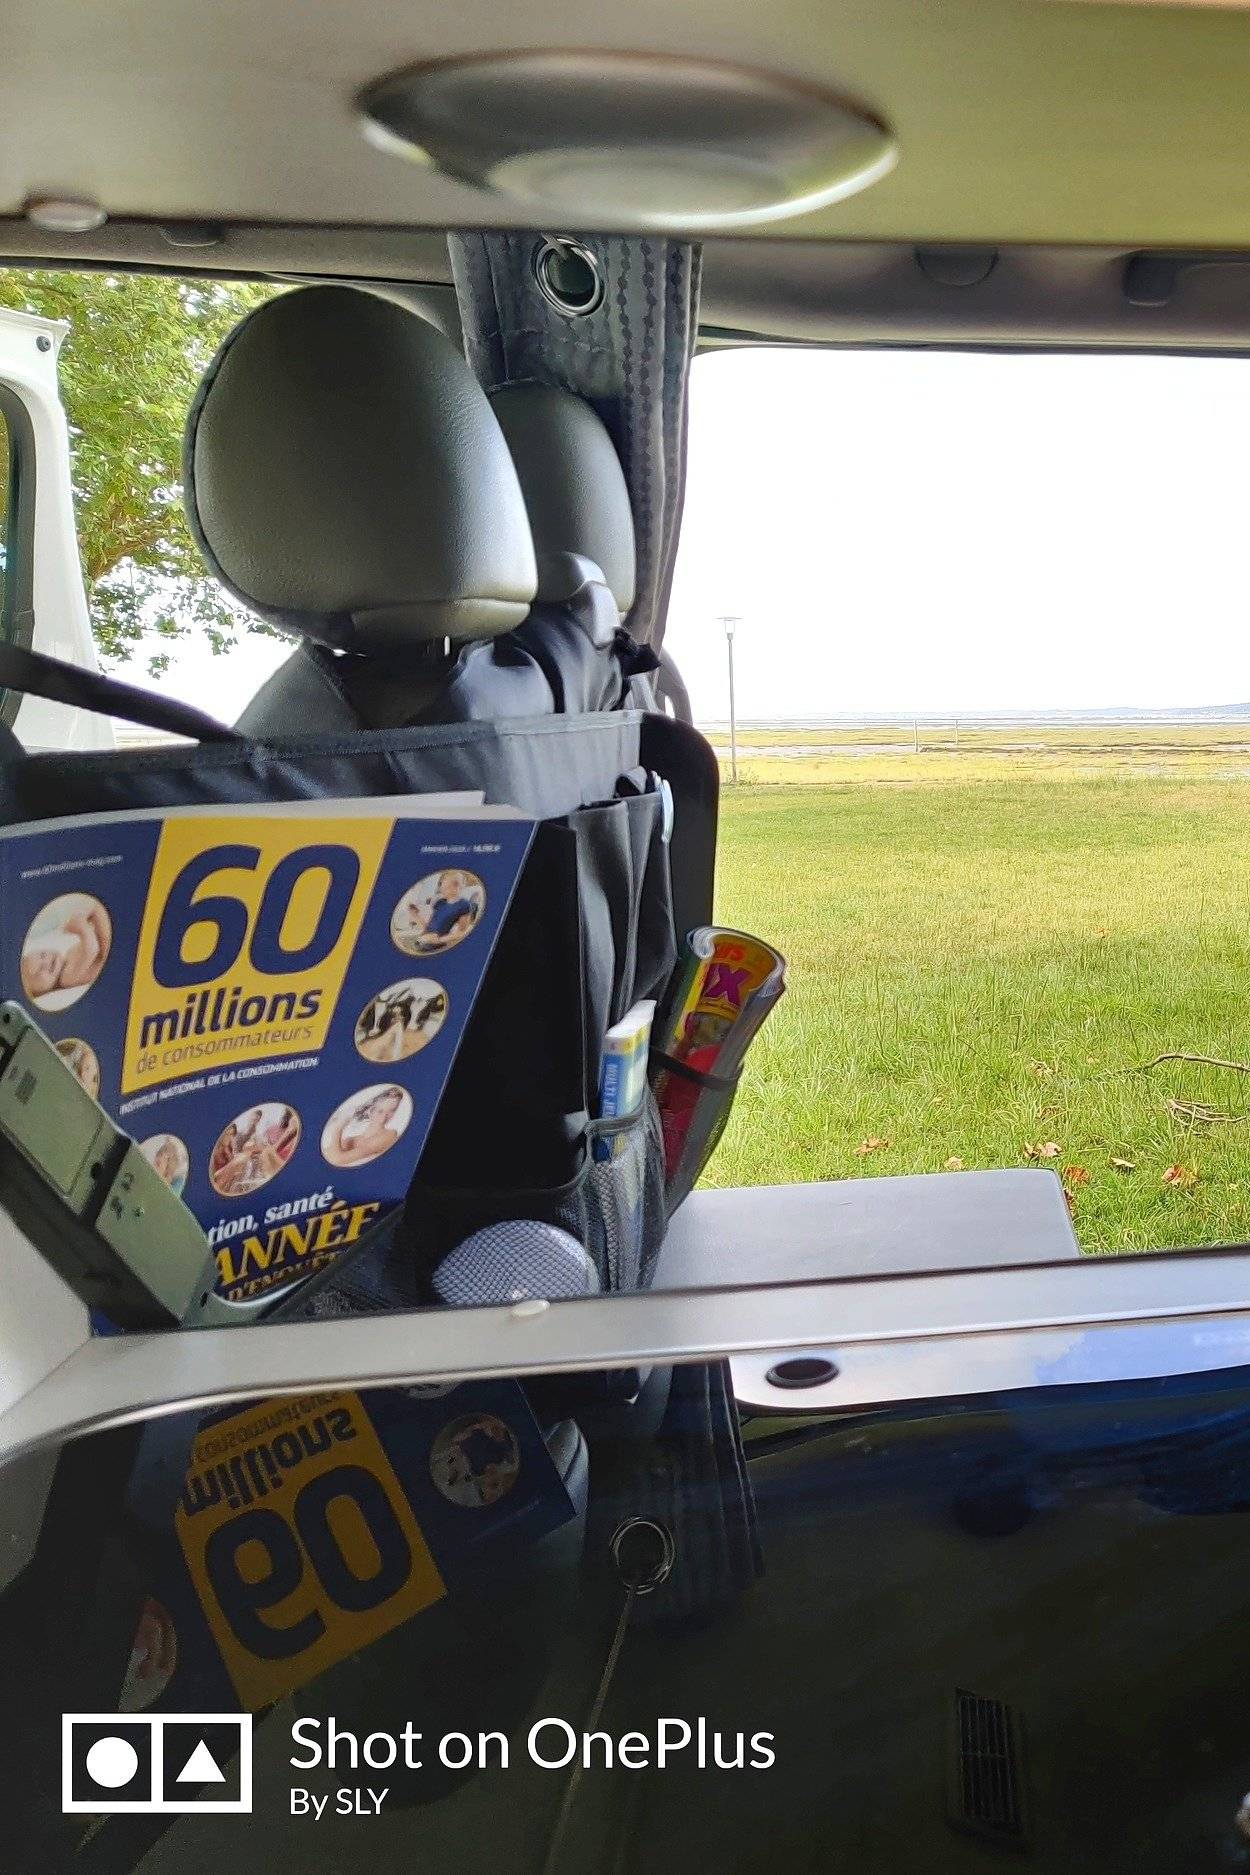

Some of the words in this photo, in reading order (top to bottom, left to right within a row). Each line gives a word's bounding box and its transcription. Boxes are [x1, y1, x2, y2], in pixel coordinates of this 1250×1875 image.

[153, 844, 360, 989] 60
[139, 986, 323, 1050] millions
[136, 1051, 158, 1074] de
[162, 1025, 314, 1066] consommateurs
[159, 1076, 206, 1100] NATIONAL
[207, 1074, 221, 1087] DE
[222, 1071, 236, 1083] LA
[237, 1056, 320, 1080] CONSOMMATION
[263, 1185, 335, 1225] santé
